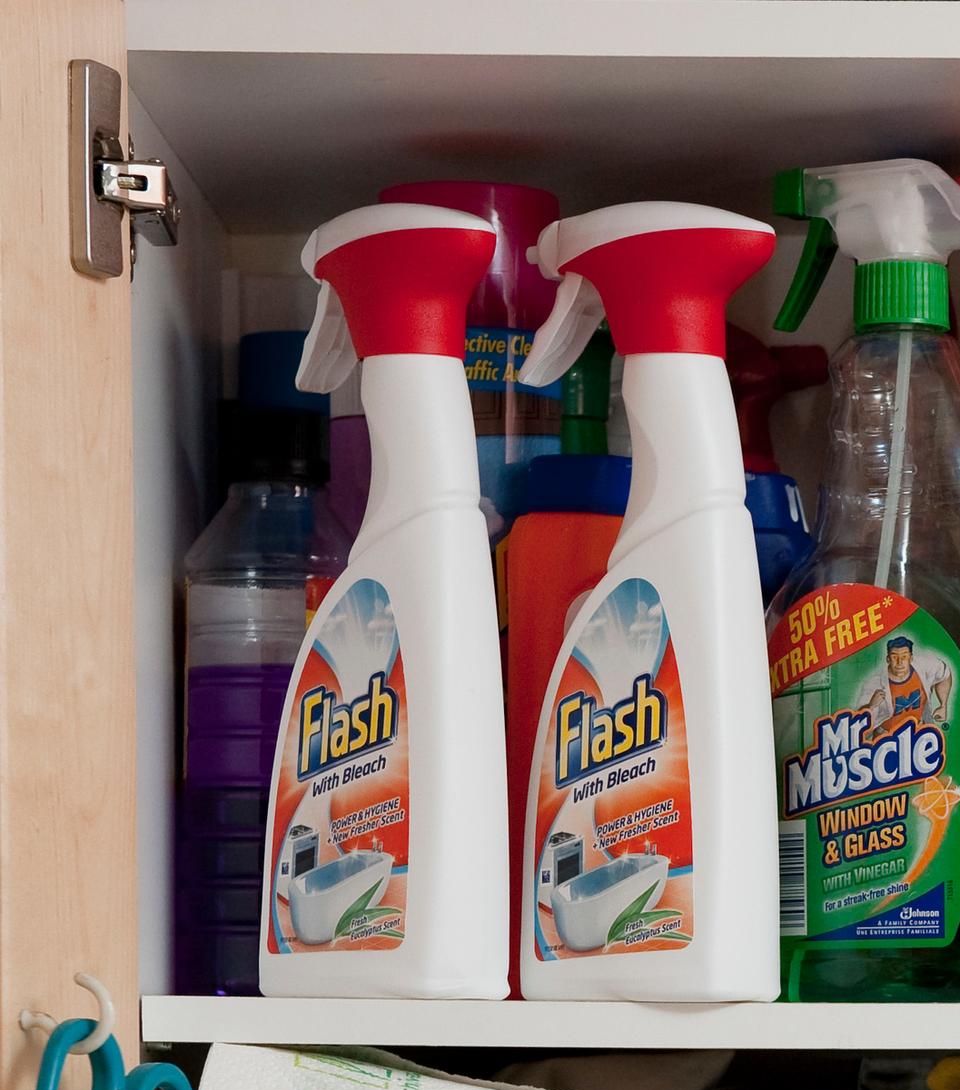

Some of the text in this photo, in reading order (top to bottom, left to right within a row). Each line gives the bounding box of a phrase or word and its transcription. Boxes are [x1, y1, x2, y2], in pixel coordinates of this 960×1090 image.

[788, 591, 841, 644] 50%
[301, 673, 395, 775] Flash
[558, 677, 661, 781] Flash
[823, 712, 868, 760] Mr
[312, 753, 387, 798] With Bleach
[573, 757, 656, 804] With Bleach
[788, 725, 943, 812] Muscle
[331, 798, 400, 832] POWER & HYGIENE
[333, 810, 405, 844] New Fresher Scent
[597, 799, 673, 837] POWER & HYGIENE
[599, 812, 679, 849] New Fresher Scent
[820, 793, 907, 836] WINDOW
[824, 825, 905, 864] & GLASS
[823, 858, 906, 892] WITH VINEGAR
[825, 882, 910, 912] For a streak-free shine
[350, 916, 368, 929] Fresh
[350, 917, 401, 941] Eucalyptus Scent
[625, 920, 644, 933] Fresh
[625, 919, 681, 946] Eucalyptus Scent
